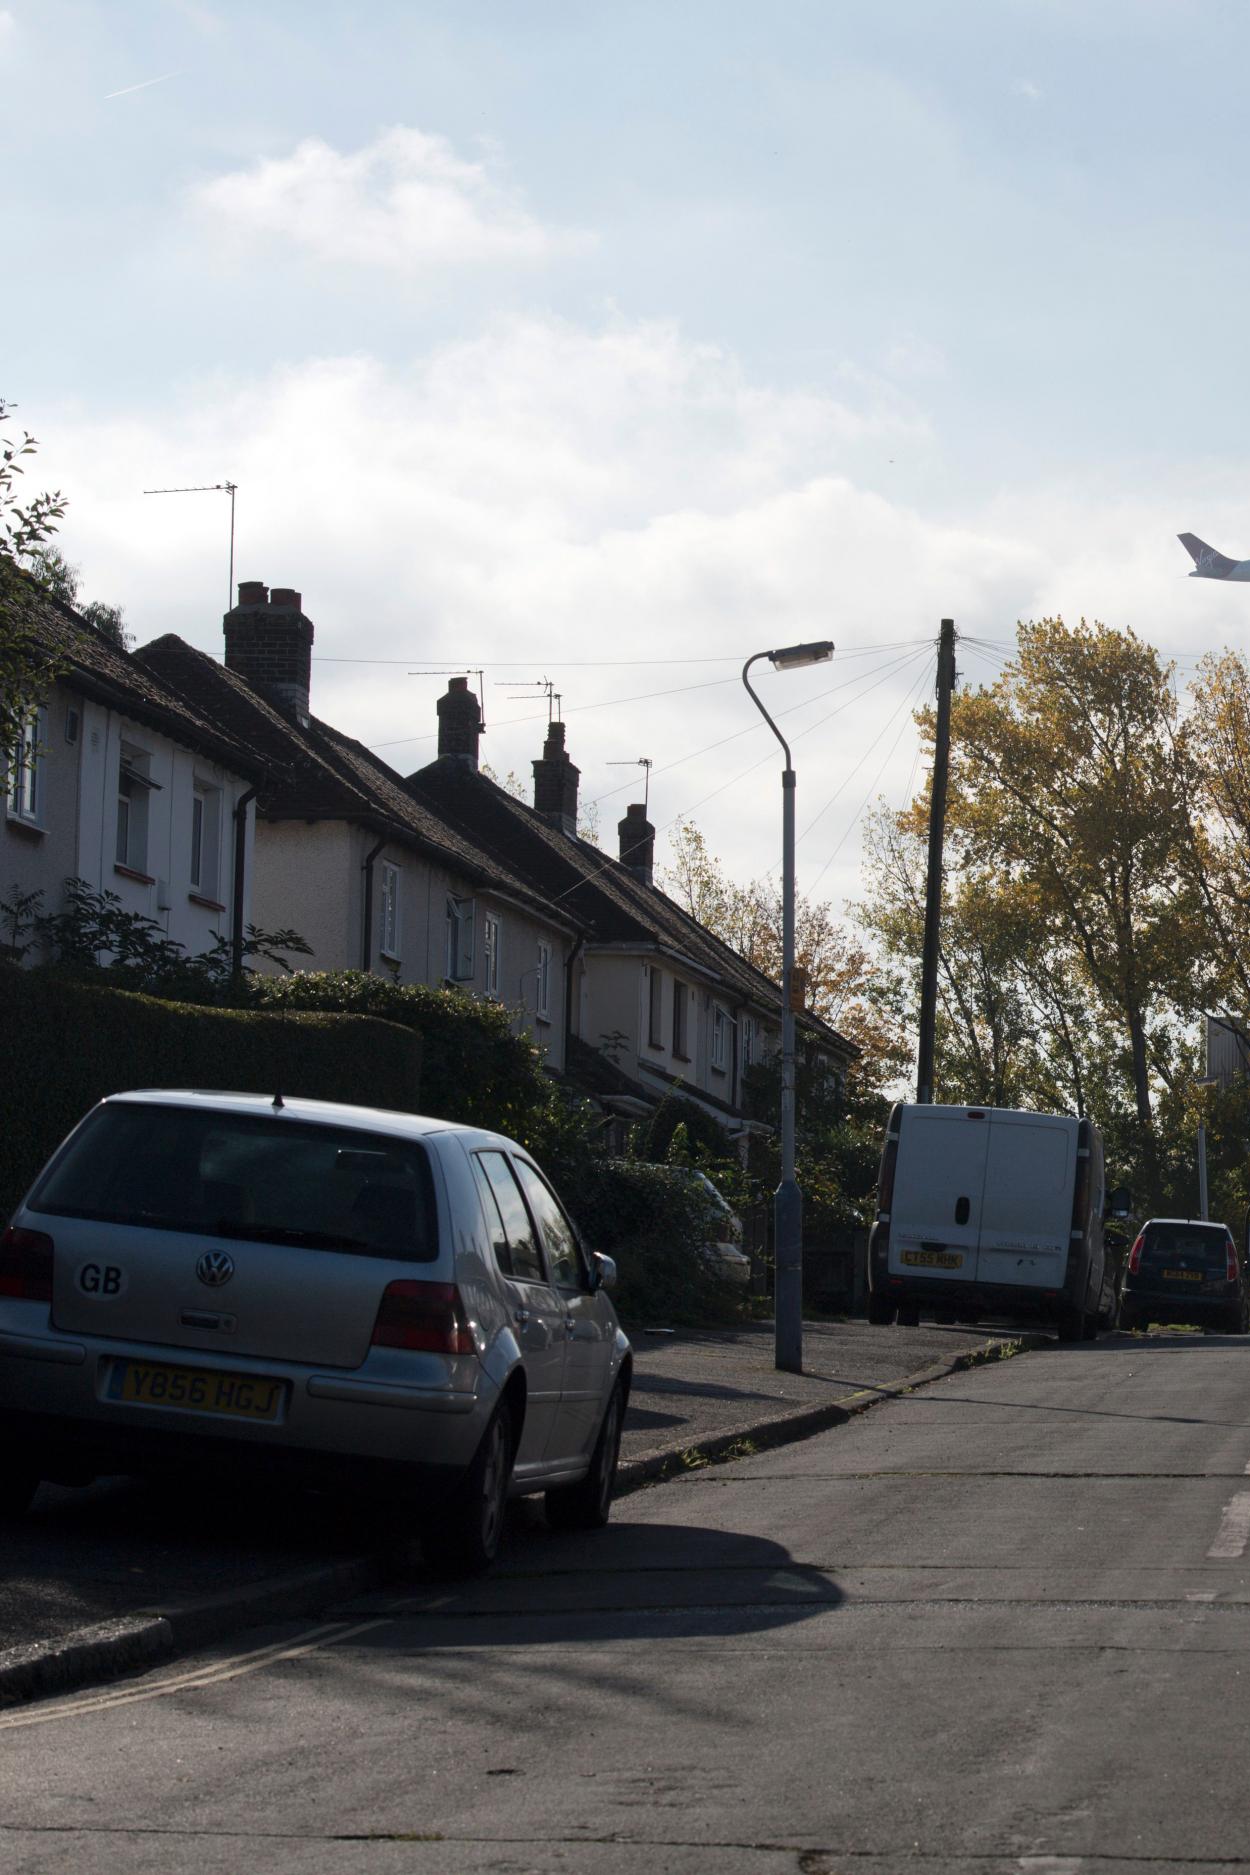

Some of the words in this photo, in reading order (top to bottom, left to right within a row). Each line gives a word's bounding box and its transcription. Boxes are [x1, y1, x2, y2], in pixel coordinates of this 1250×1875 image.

[80, 1263, 122, 1294] GB
[133, 1369, 209, 1403] Y856
[214, 1379, 281, 1413] HGJ
